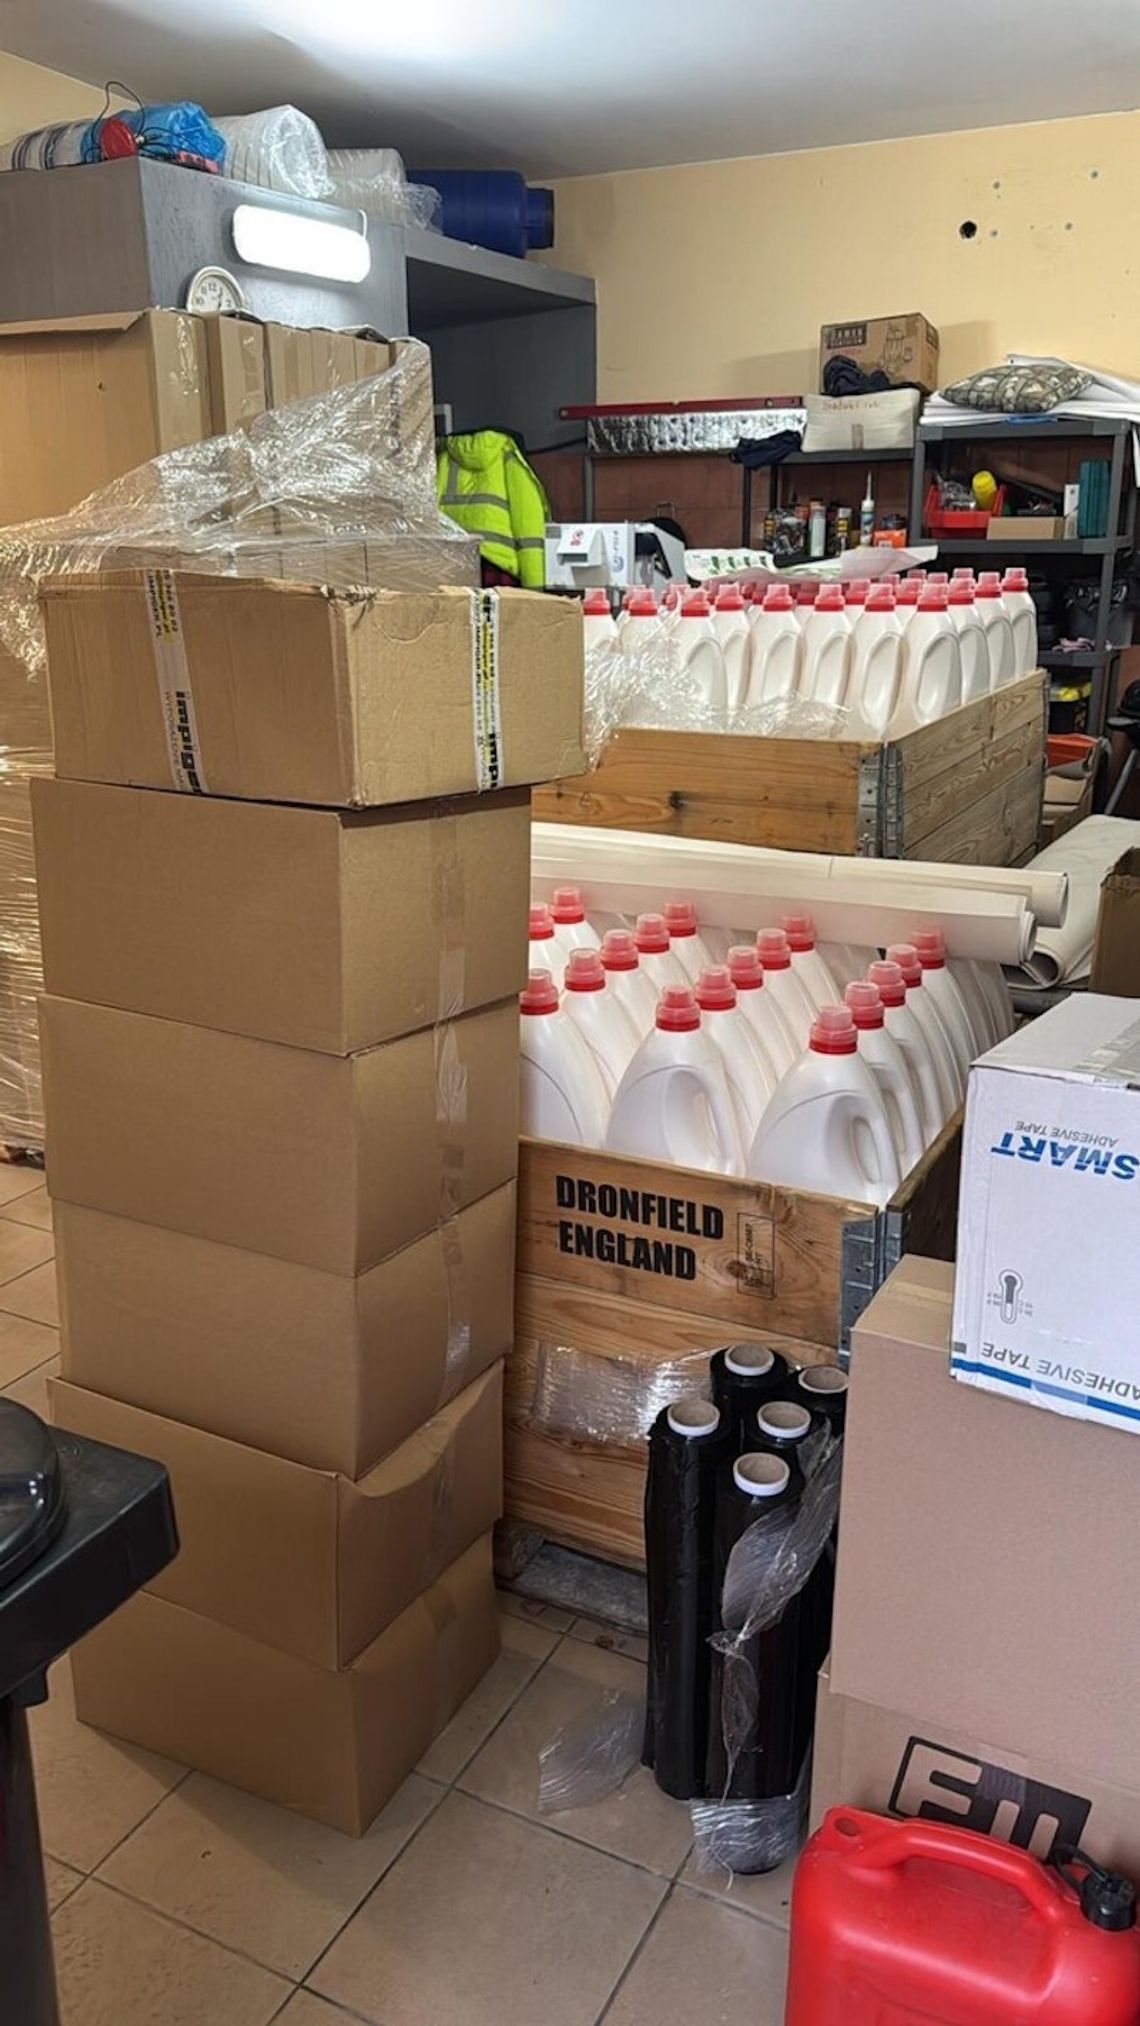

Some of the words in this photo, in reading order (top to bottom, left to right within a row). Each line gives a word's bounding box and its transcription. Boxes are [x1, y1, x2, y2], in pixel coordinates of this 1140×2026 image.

[176, 690, 202, 793] impige
[1013, 1120, 1048, 1137] TAPE
[1048, 1127, 1119, 1149] ADHESIVE
[990, 1132, 1140, 1181] SMART
[556, 1175, 724, 1241] DRONFIELD
[559, 1220, 696, 1281] ENGLAND
[980, 1341, 1031, 1371] TAPE
[1036, 1358, 1140, 1402] ADHESIVE
